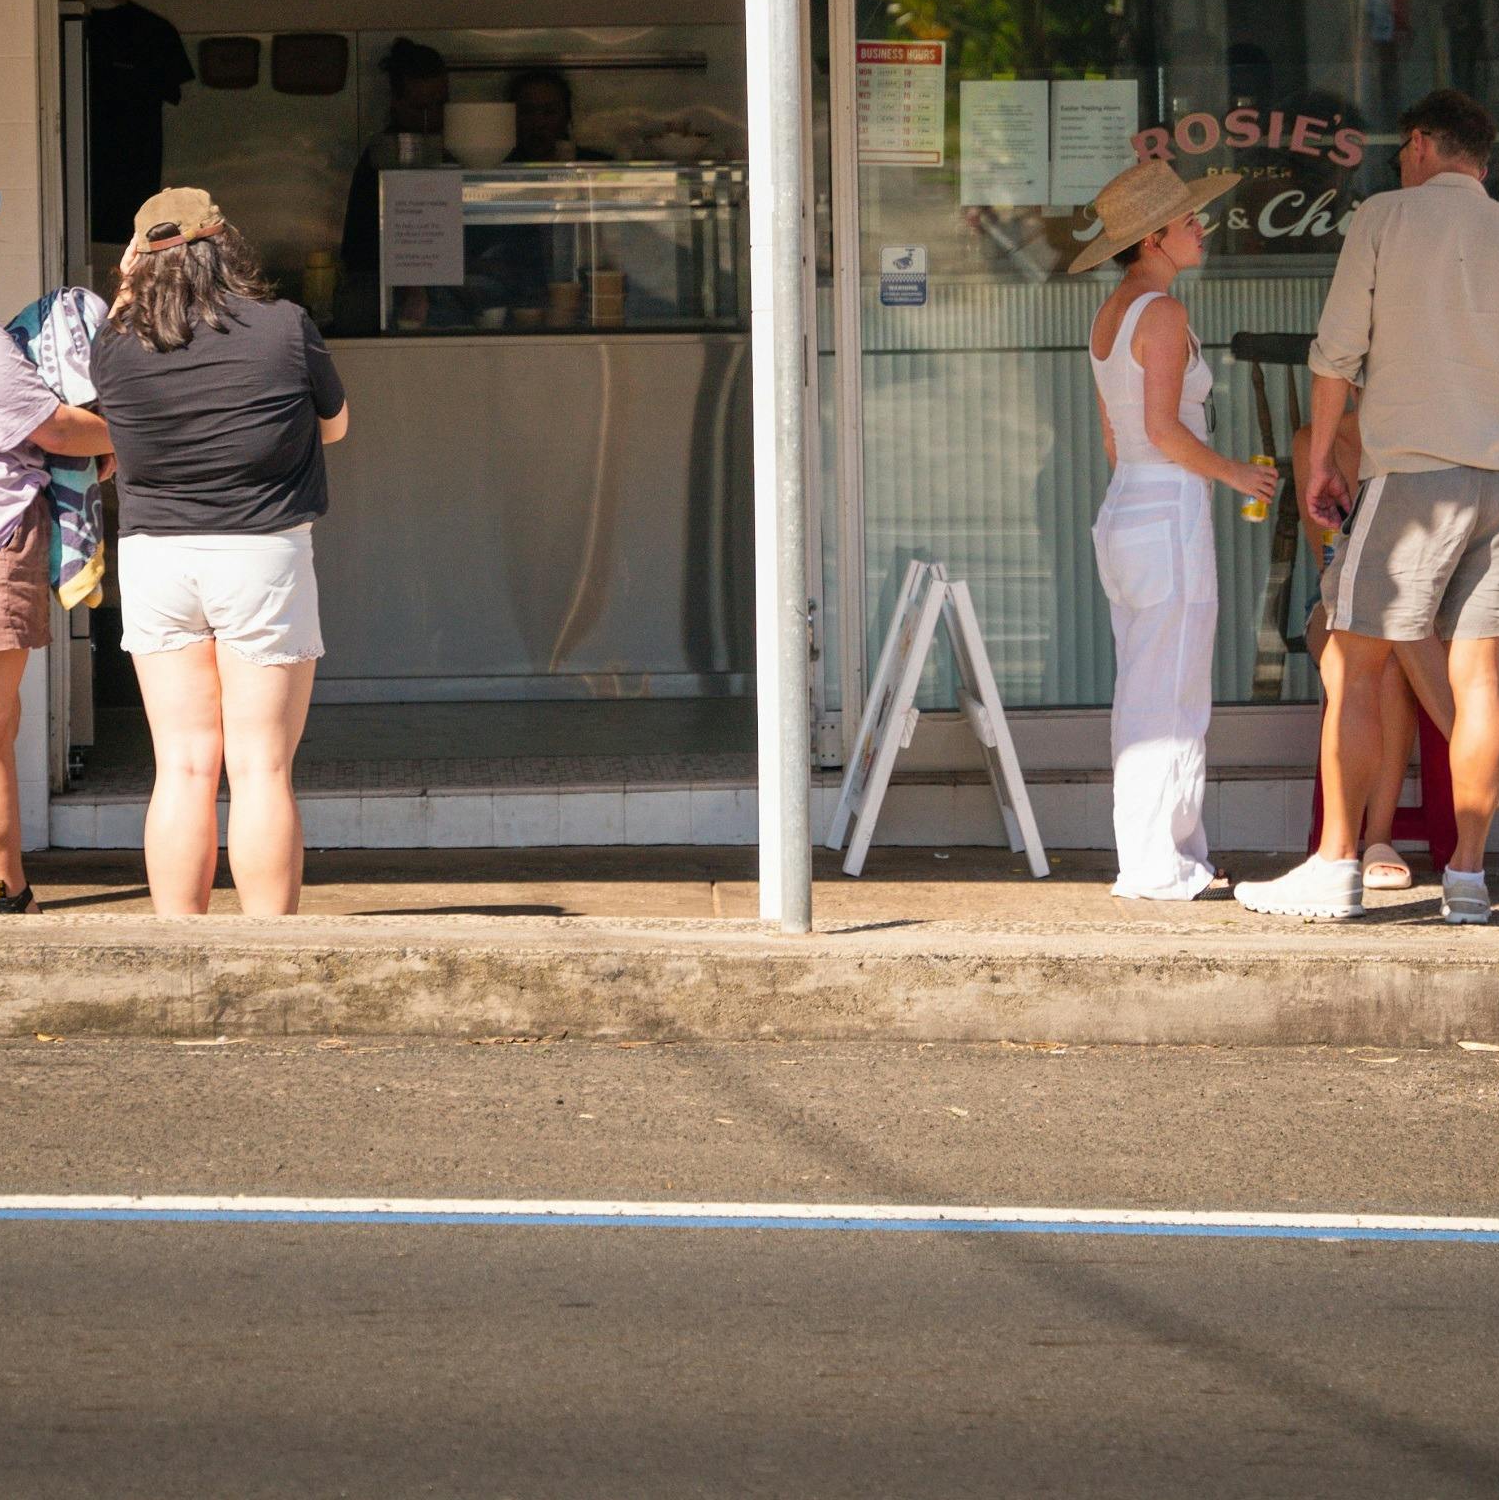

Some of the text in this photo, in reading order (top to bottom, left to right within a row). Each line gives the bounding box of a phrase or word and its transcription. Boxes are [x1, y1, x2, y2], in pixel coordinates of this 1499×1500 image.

[860, 47, 936, 61] BUSINESS HOURS
[1130, 107, 1371, 169] ROSIE'S
[1227, 208, 1251, 230] &
[1258, 188, 1361, 238] Chi
